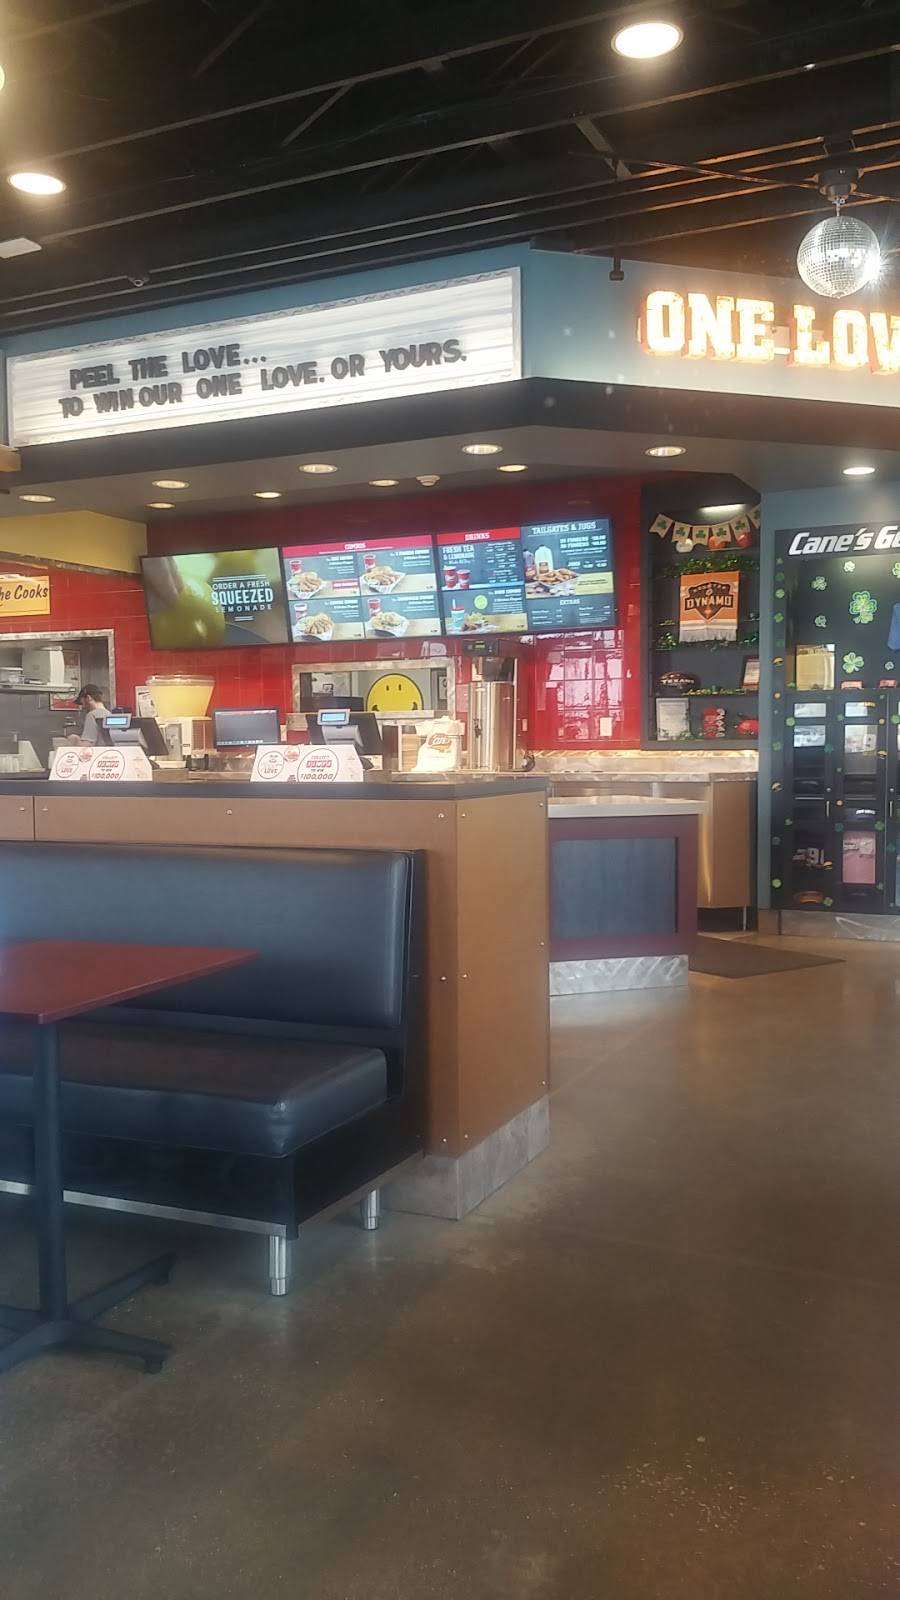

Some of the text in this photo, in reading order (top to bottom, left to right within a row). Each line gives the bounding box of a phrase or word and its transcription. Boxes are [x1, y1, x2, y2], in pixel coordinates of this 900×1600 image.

[641, 290, 775, 362] ONE
[69, 343, 267, 390] PEEL THE LOVE...
[58, 339, 468, 418] TO WIN OUR ONE LOVE. OR YOURS.
[531, 523, 570, 535] TAILGATES
[578, 521, 597, 531] JUGS
[464, 531, 490, 541] DRINKS
[788, 527, 875, 555] Cane's
[442, 545, 462, 554] FRESH
[14, 583, 49, 600] Cooks
[212, 580, 270, 590] ORDER A FRESH
[211, 588, 274, 606] SQUEEZED
[686, 595, 732, 609] DYNAMO
[215, 603, 273, 613] LEMONADE
